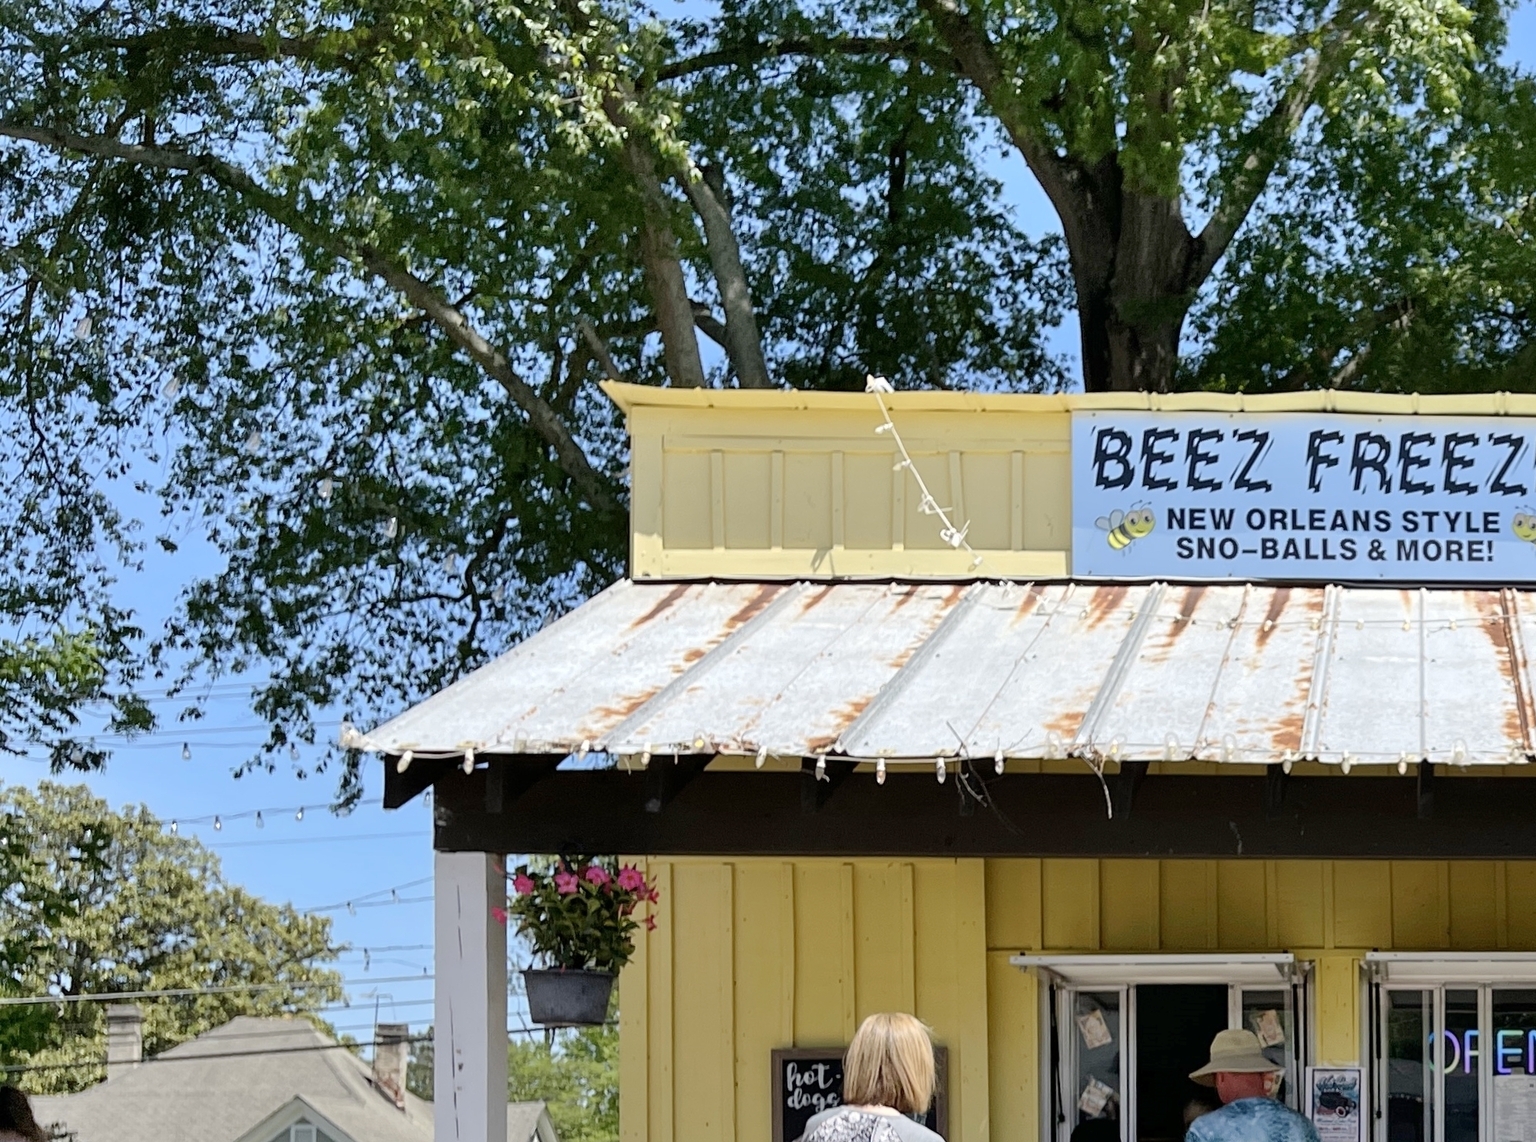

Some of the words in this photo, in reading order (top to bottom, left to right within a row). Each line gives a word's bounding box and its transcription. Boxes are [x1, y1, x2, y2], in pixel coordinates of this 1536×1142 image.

[1091, 426, 1274, 492] BEEZ
[1167, 508, 1235, 532] NEW
[1246, 508, 1392, 533] ORLEANS
[1403, 510, 1500, 534] STYLE
[1176, 537, 1363, 561] SNO-BALLS
[1368, 539, 1386, 562] &
[1396, 539, 1494, 563] MORE!
[787, 1087, 841, 1113] dogs
